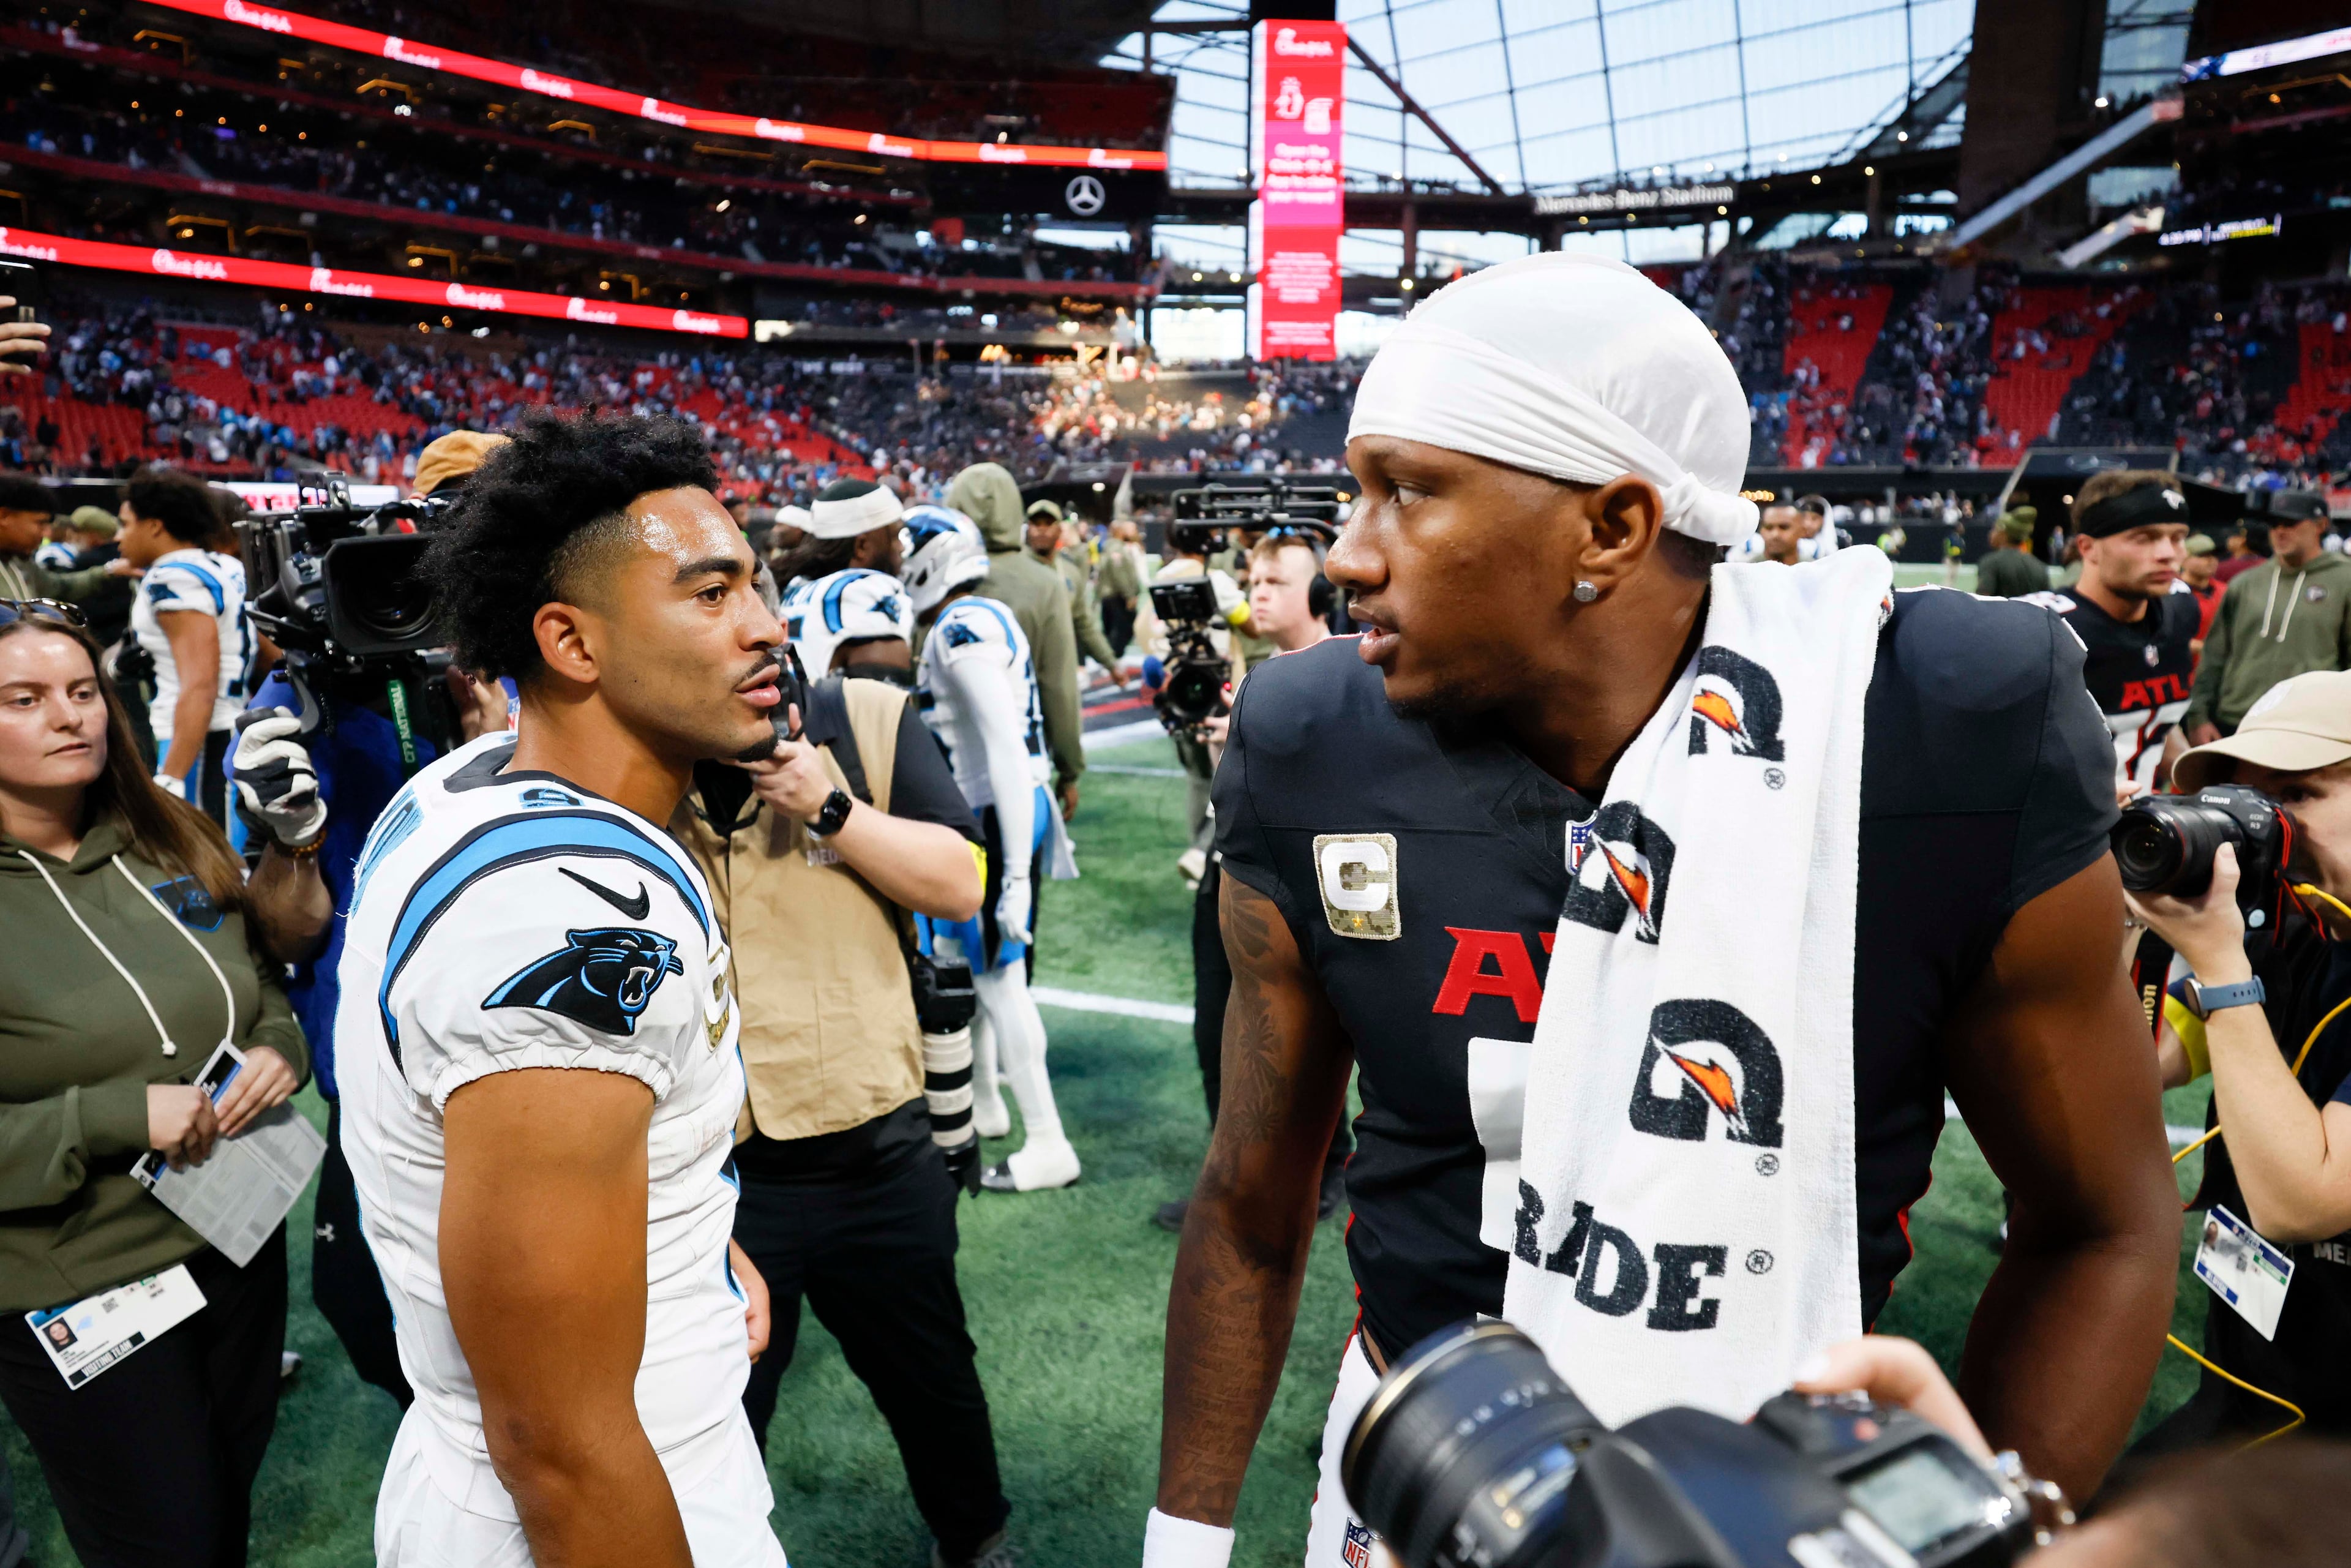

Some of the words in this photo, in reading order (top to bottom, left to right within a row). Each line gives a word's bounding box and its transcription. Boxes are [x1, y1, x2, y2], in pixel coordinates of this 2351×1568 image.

[1660, 186, 1733, 206] Stadium
[2201, 794, 2230, 805] Canon
[1321, 842, 1389, 912] C
[1432, 926, 1556, 1023] A
